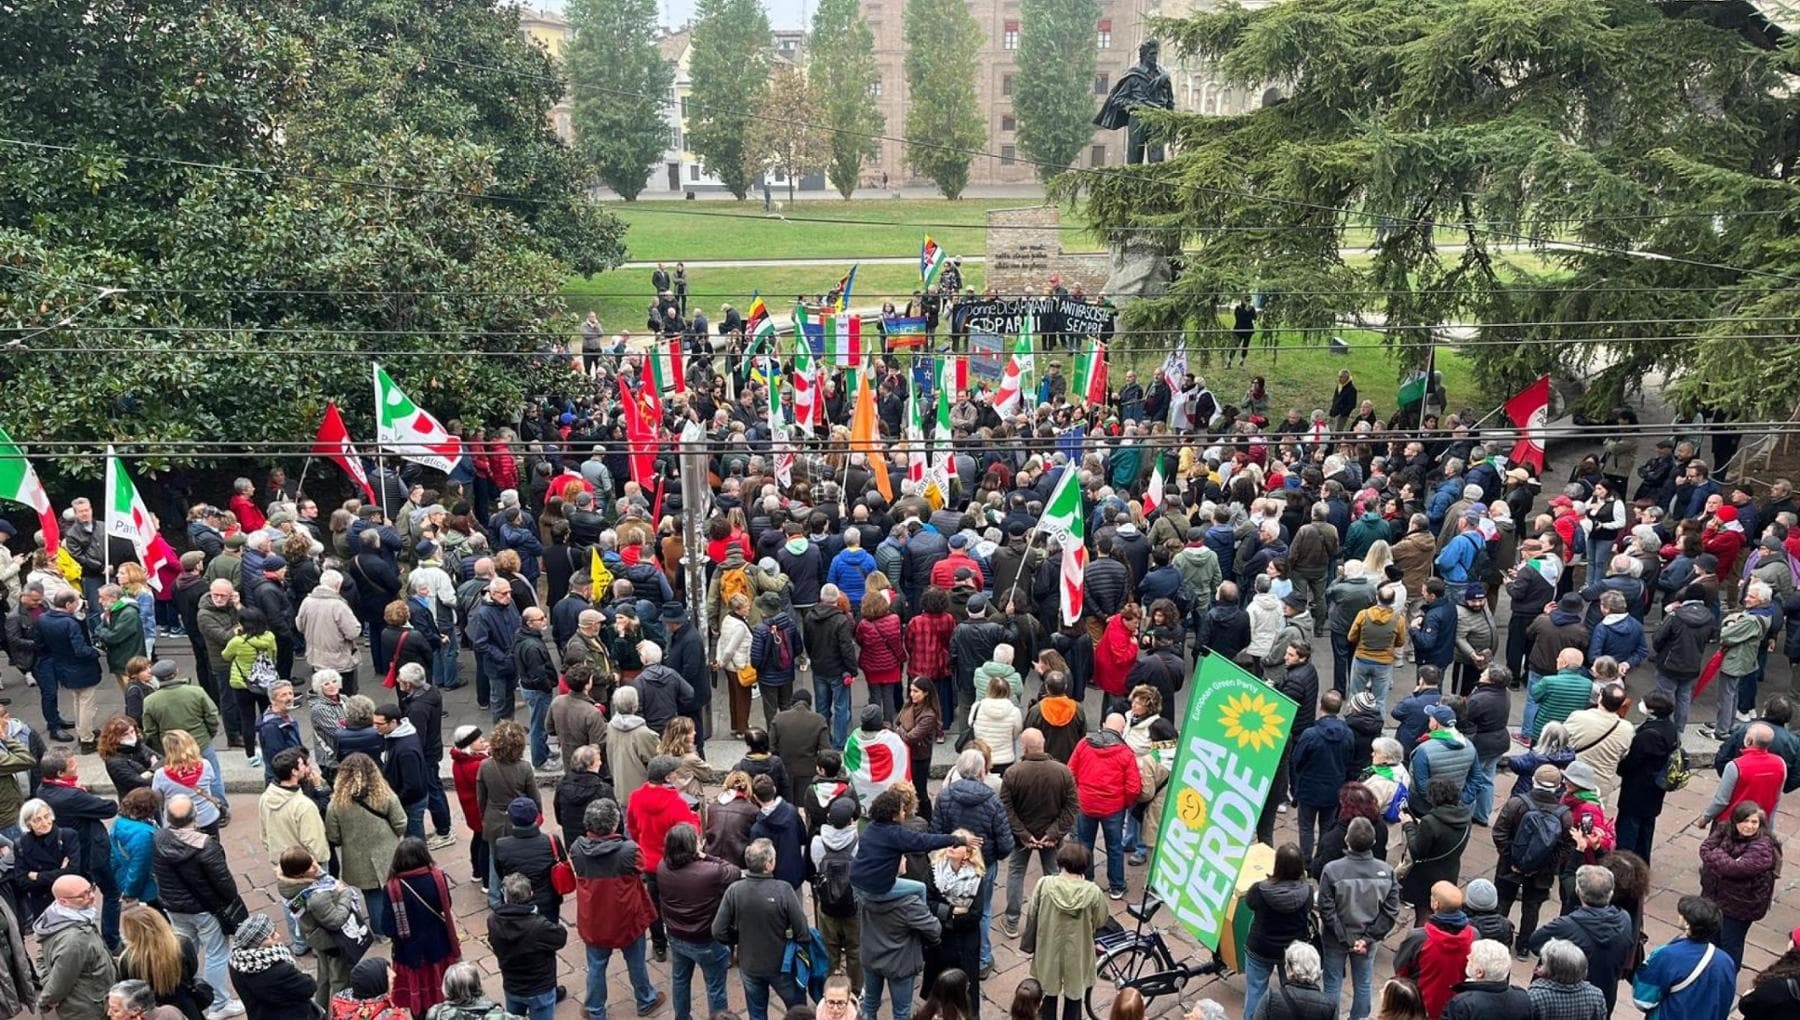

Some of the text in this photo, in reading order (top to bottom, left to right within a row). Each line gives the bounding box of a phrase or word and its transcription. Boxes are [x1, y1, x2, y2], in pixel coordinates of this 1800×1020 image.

[1191, 679, 1259, 721] European Green Party
[1177, 752, 1269, 935] VERDE
